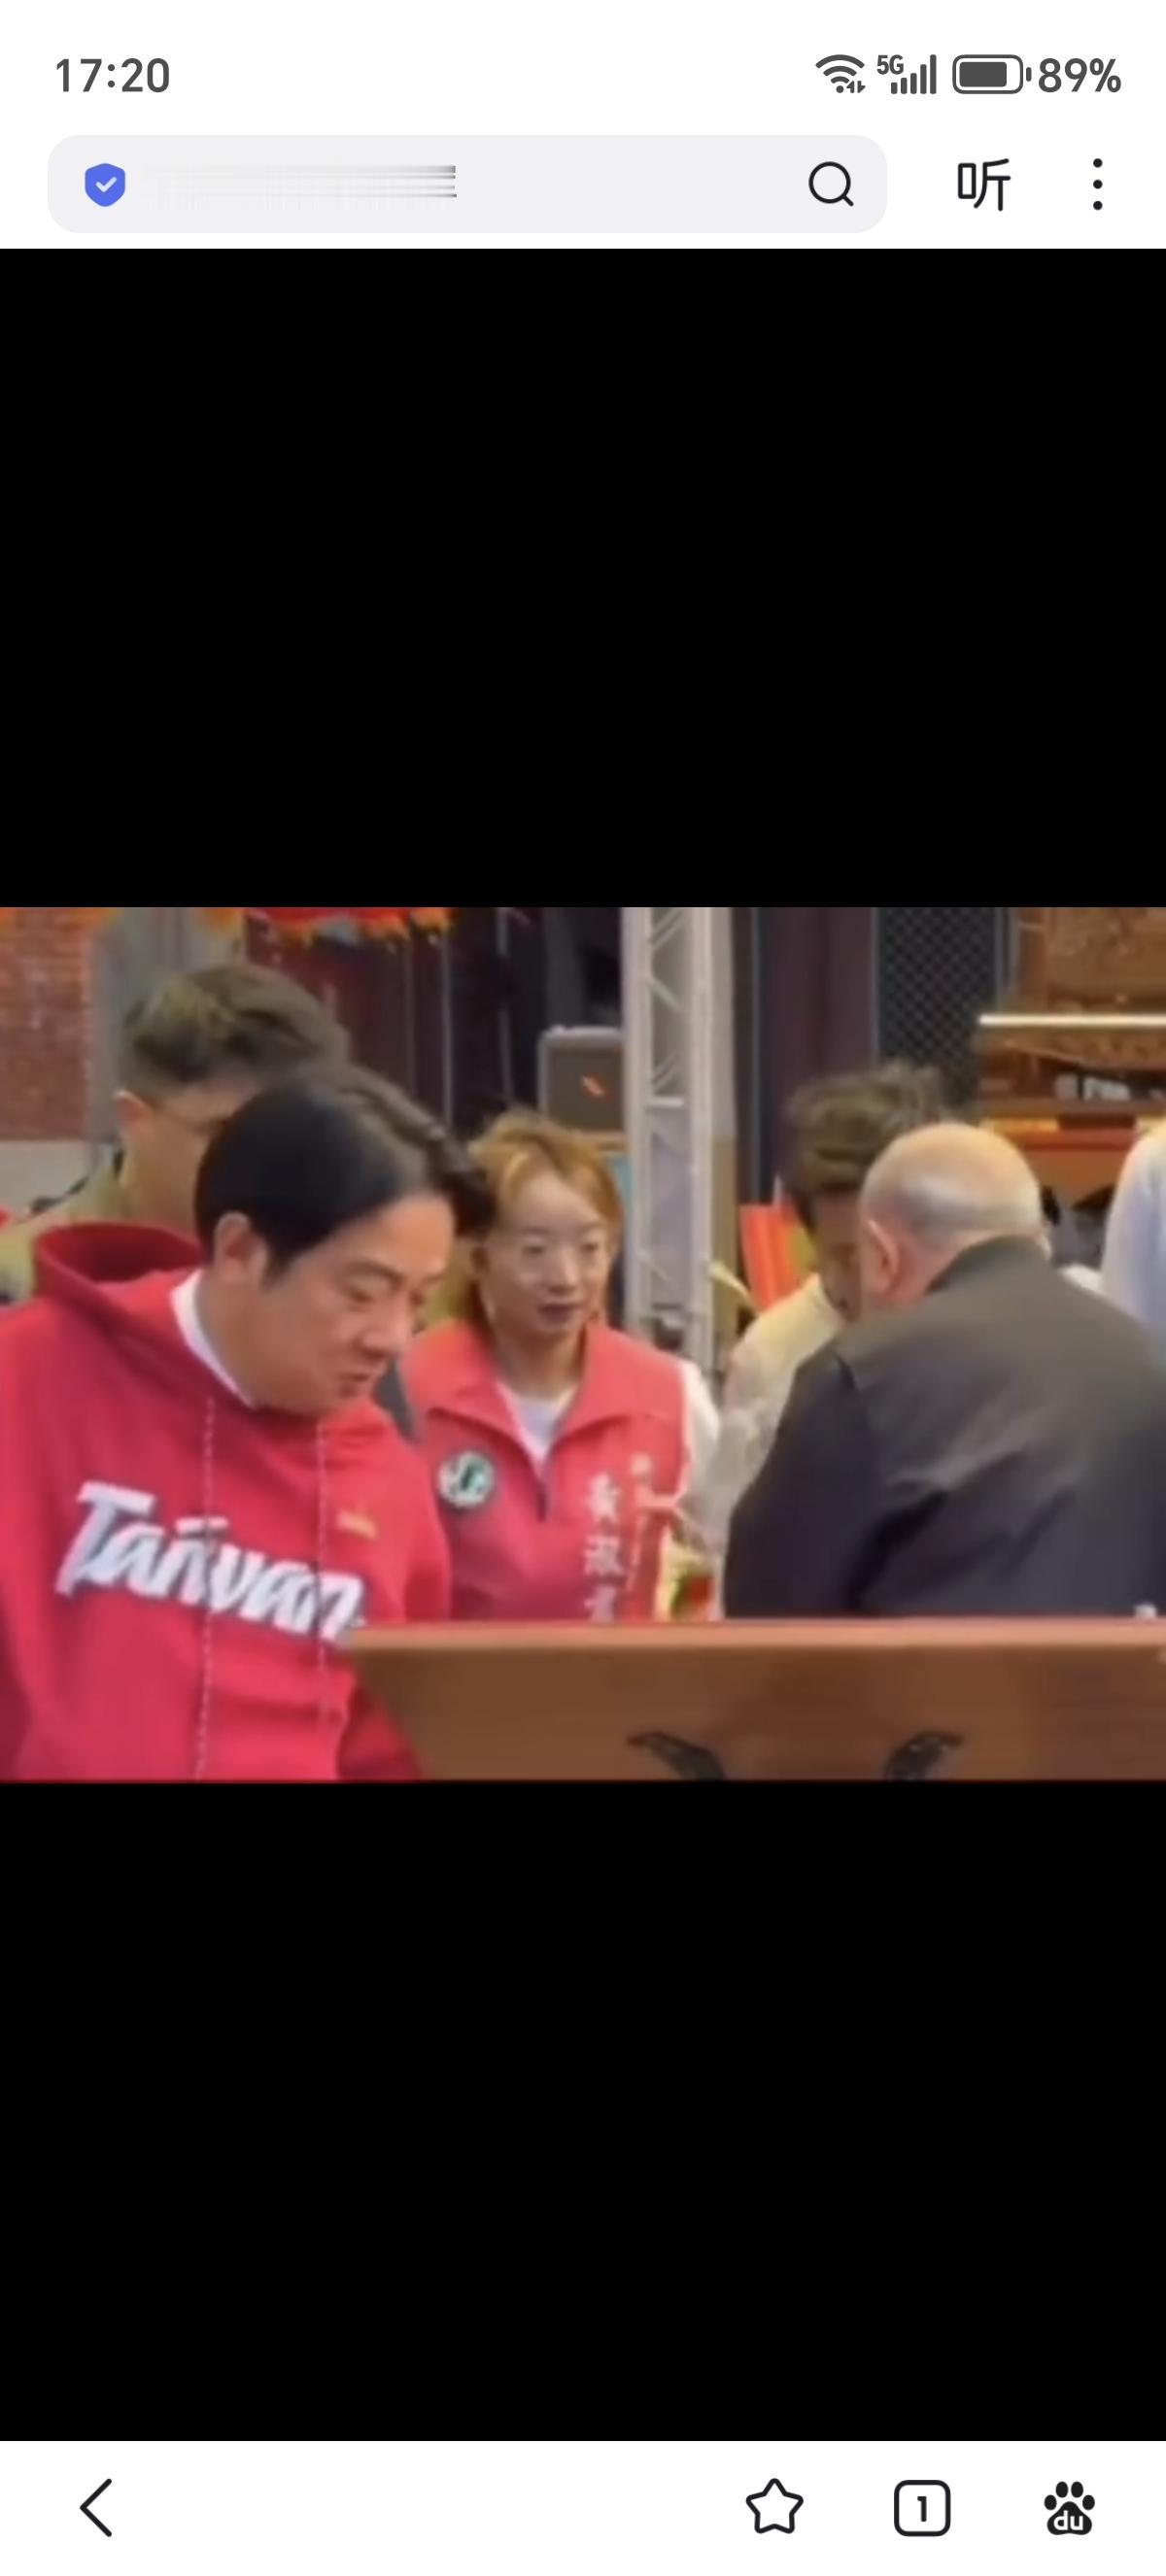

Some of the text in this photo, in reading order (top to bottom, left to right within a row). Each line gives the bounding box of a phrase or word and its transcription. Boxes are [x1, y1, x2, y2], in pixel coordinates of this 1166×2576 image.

[56, 57, 170, 93] 17:20
[876, 54, 905, 76] 5G
[1038, 57, 1122, 93] 89%
[957, 157, 1012, 212] 听
[916, 2495, 927, 2523] 1
[1053, 2509, 1084, 2531] du
